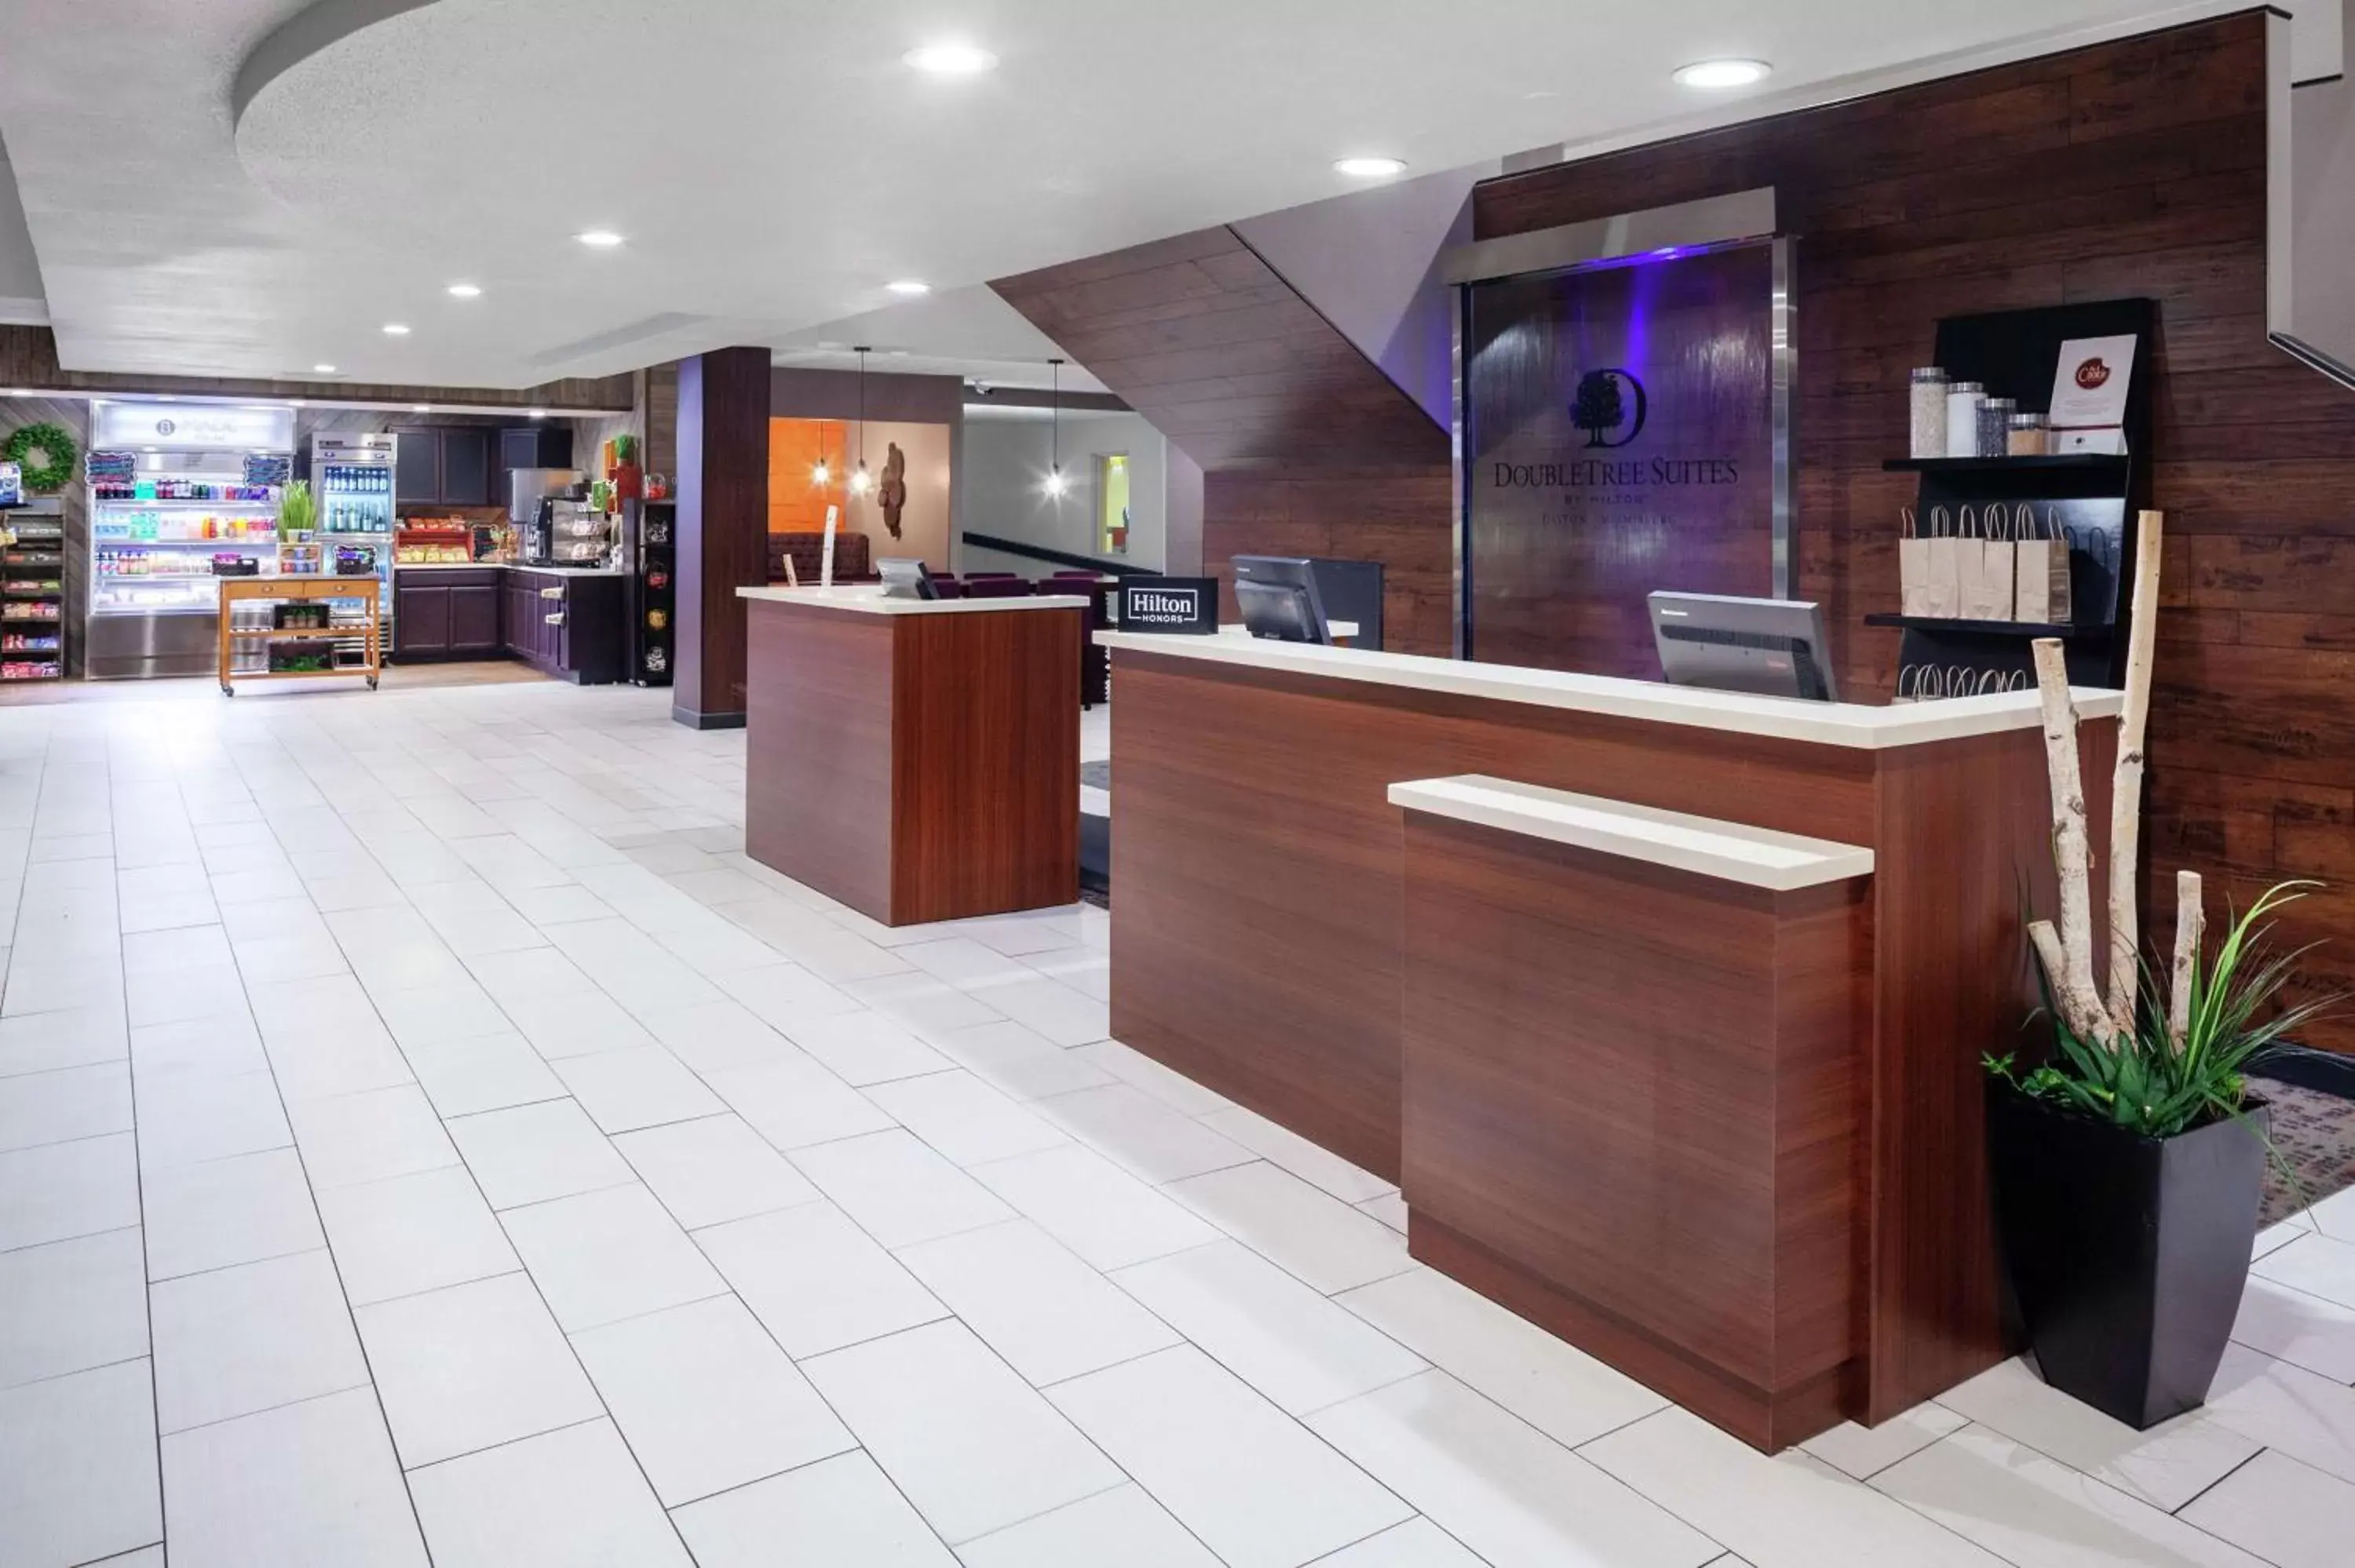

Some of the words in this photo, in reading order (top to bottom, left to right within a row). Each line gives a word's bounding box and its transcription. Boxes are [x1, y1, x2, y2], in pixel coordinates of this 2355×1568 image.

[1494, 459, 1646, 487] DOUBLETREE
[1650, 456, 1740, 486] SUITES
[1134, 594, 1192, 613] Hilton
[1142, 614, 1183, 623] HONORS
